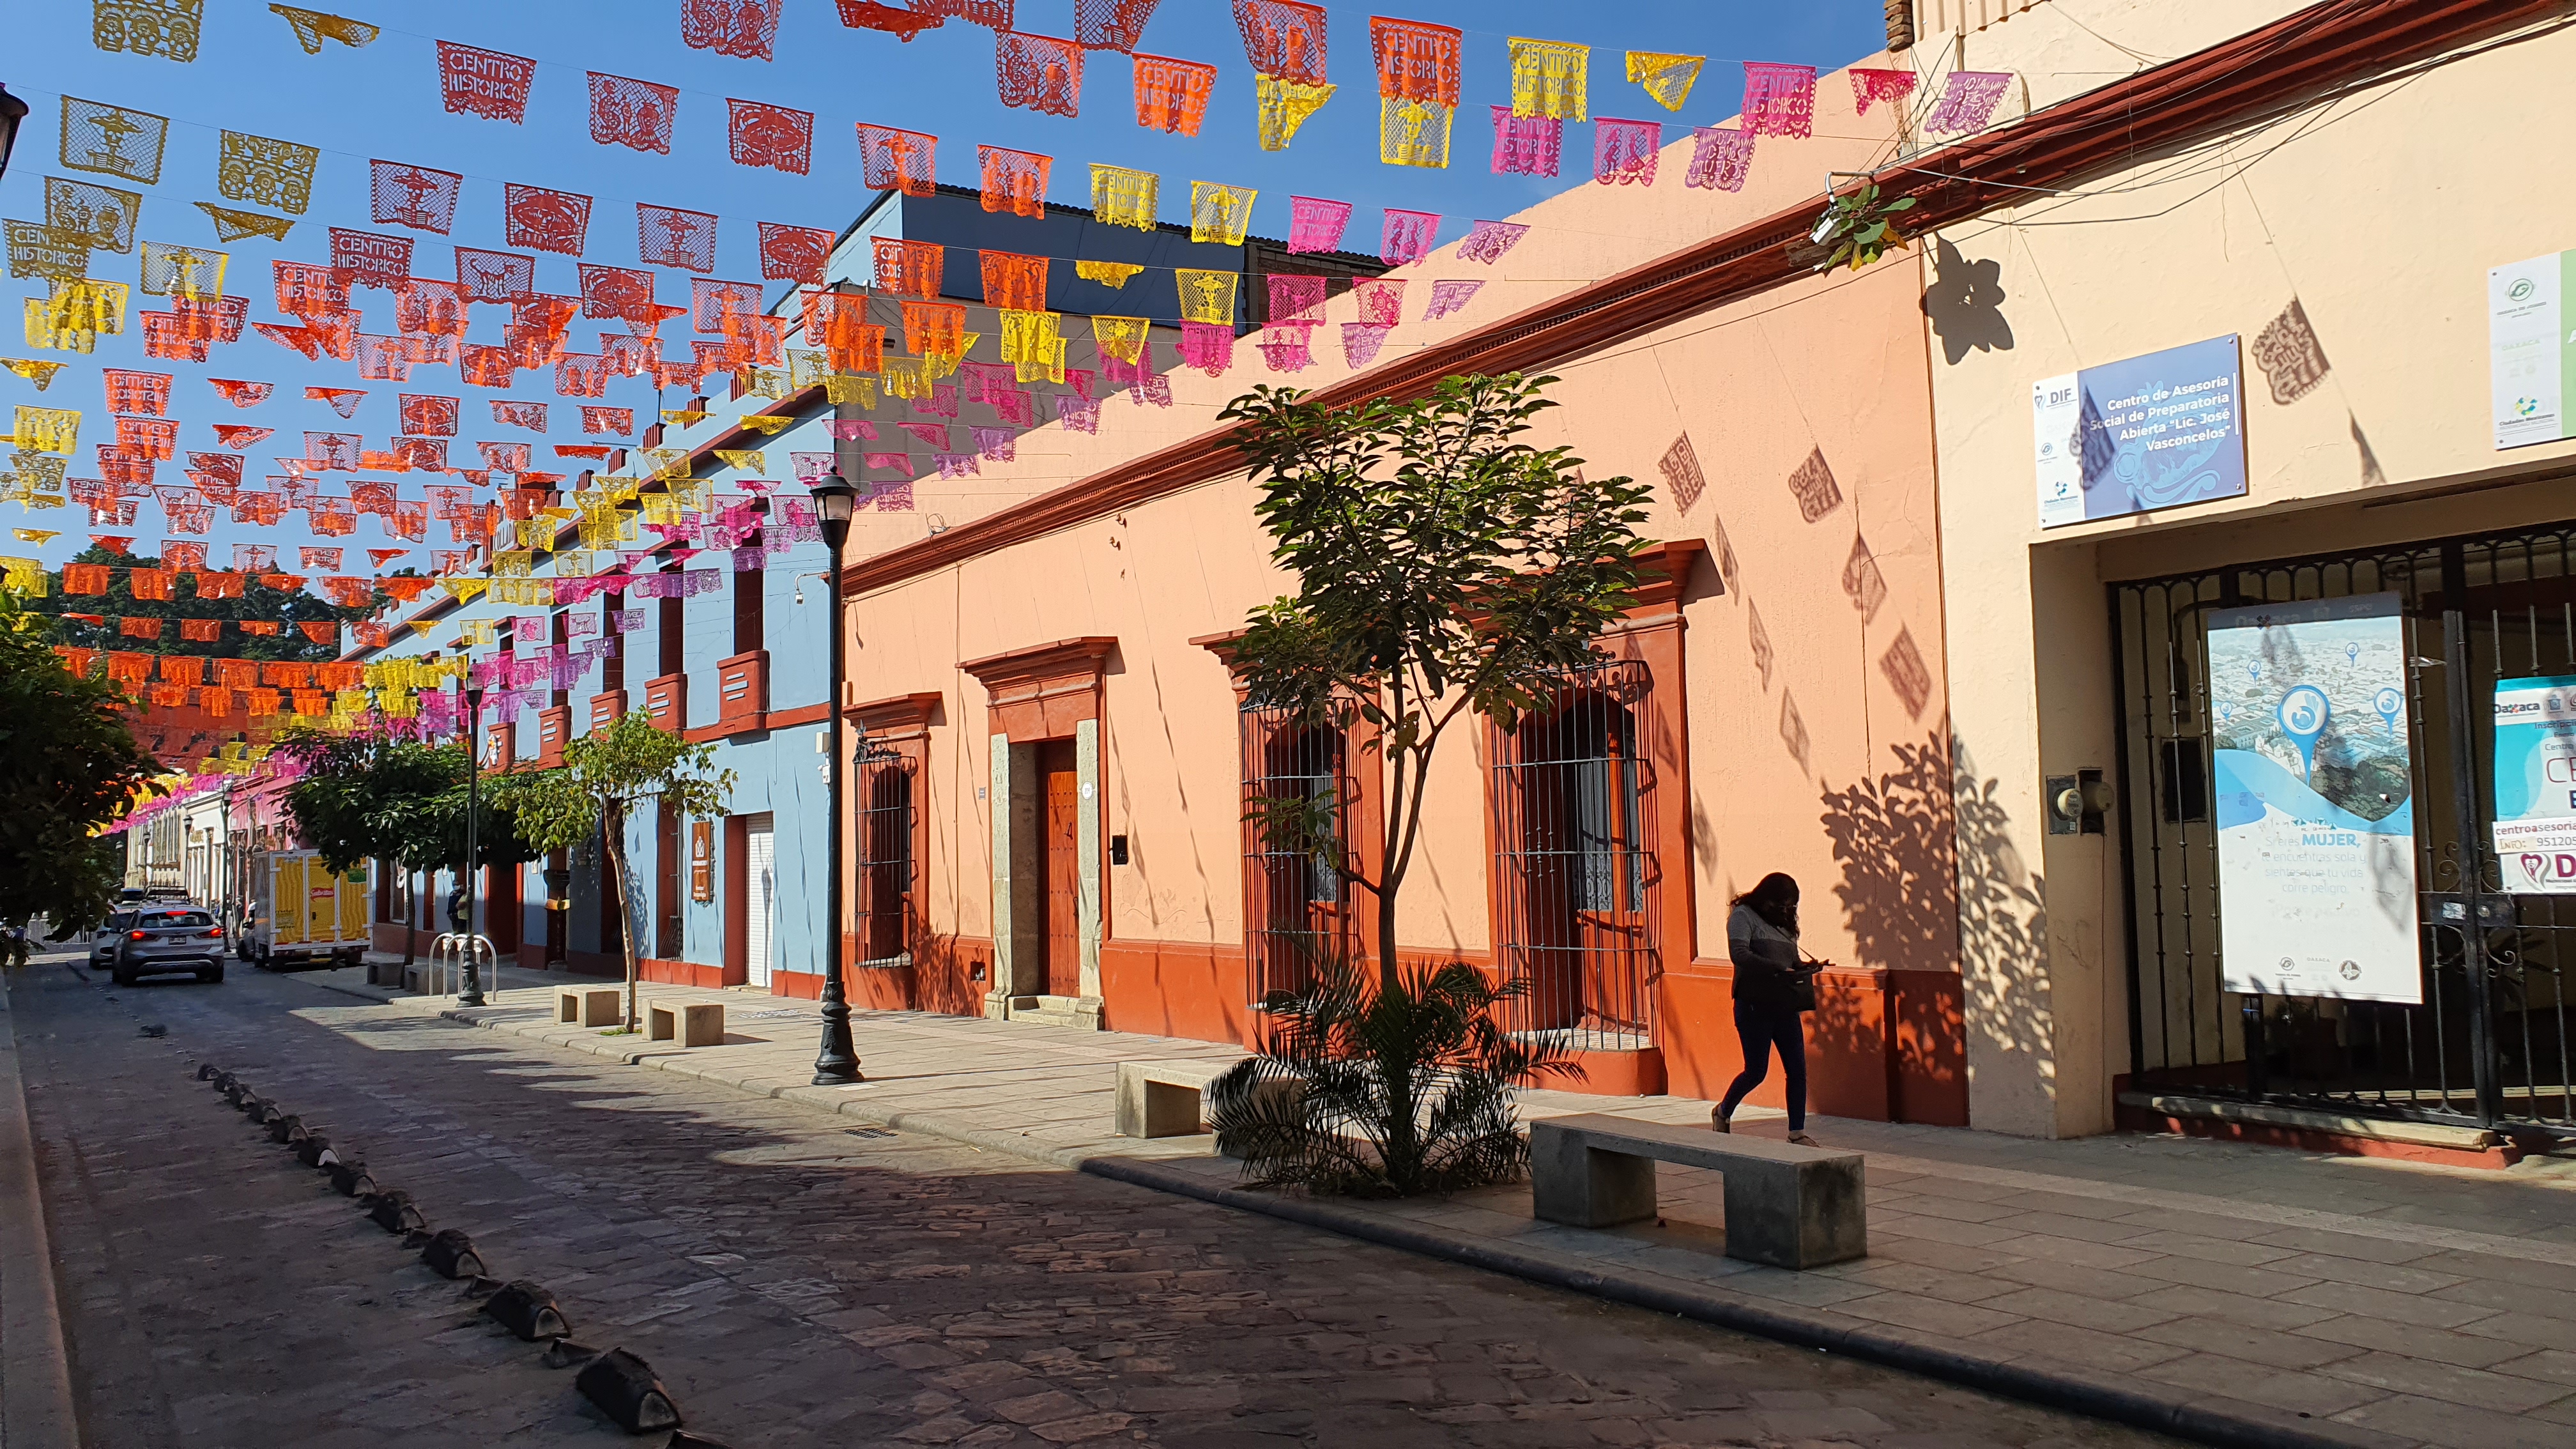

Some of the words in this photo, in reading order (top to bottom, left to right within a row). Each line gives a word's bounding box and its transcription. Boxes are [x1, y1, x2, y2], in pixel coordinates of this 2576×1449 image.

[1383, 31, 1450, 59] CENTRO
[450, 52, 523, 81] CENTRO
[1519, 51, 1581, 73] CENTRO
[448, 73, 521, 102] HISTORICO
[1143, 66, 1204, 92] CENTRO
[1517, 74, 1583, 96] HISTORICO
[1751, 75, 1806, 93] CENTRO
[1747, 96, 1807, 115] HISTORICO
[1501, 118, 1552, 136] CENTRO
[1098, 173, 1150, 193] CENTRO
[1297, 206, 1342, 221] CENTRO
[14, 246, 84, 267] HISTORICO
[339, 236, 404, 259] CENTRO
[337, 254, 404, 277] HISTORICO
[282, 284, 344, 302] HISTORICO
[2050, 388, 2071, 404] DIF
[2107, 392, 2149, 411] Centro
[2152, 388, 2169, 401] de
[2172, 376, 2229, 397] Asesoría
[2089, 413, 2126, 431] Social
[2128, 408, 2145, 422] de
[2148, 393, 2230, 418] Preparatoria
[2119, 424, 2166, 441] Abierta
[2200, 410, 2230, 425] José
[2278, 838, 2299, 847] eres
[2302, 834, 2361, 848] MUJER,
[2274, 853, 2331, 862] encuentras
[2334, 853, 2356, 862] sola
[2266, 868, 2301, 878] sientes
[2304, 869, 2325, 878] que
[2327, 869, 2338, 878] tu
[2341, 868, 2363, 878] vida
[2283, 884, 2308, 893] corre
